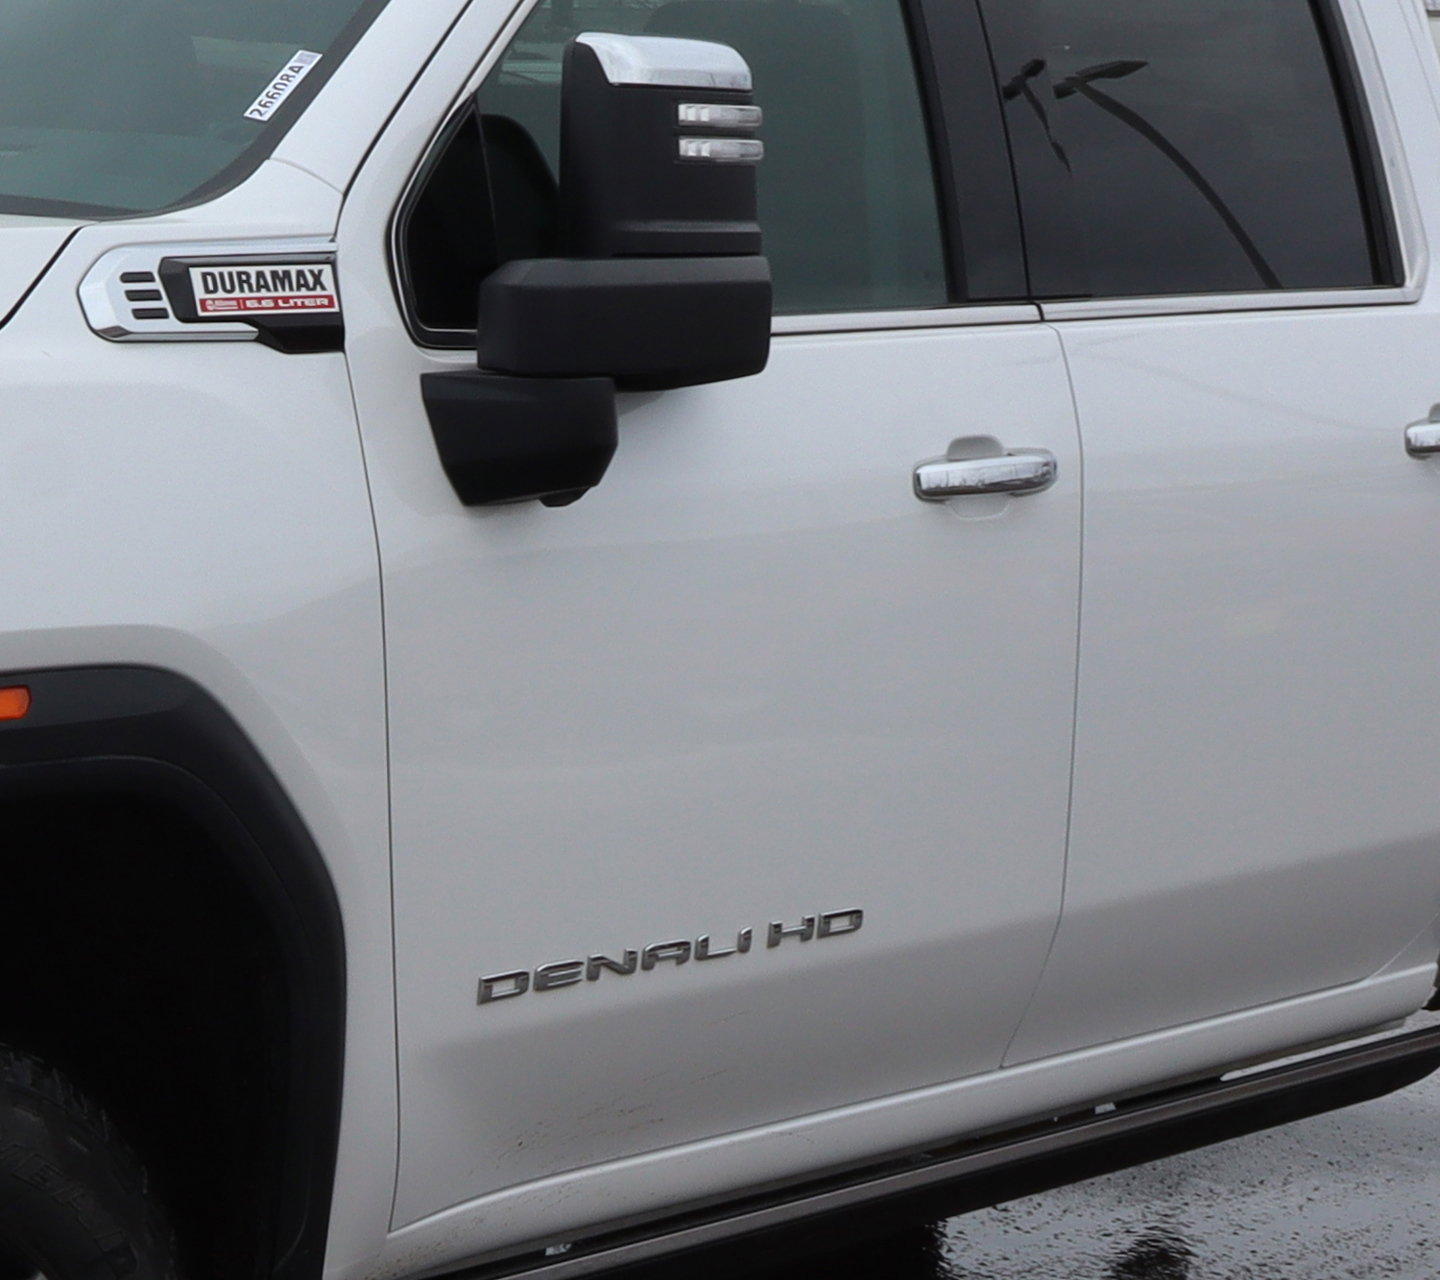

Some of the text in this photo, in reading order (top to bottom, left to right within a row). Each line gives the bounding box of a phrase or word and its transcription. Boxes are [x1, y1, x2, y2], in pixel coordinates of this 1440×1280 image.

[200, 268, 327, 295] DURAMAX
[277, 296, 329, 308] LITER
[476, 907, 864, 1006] DENALI HD
